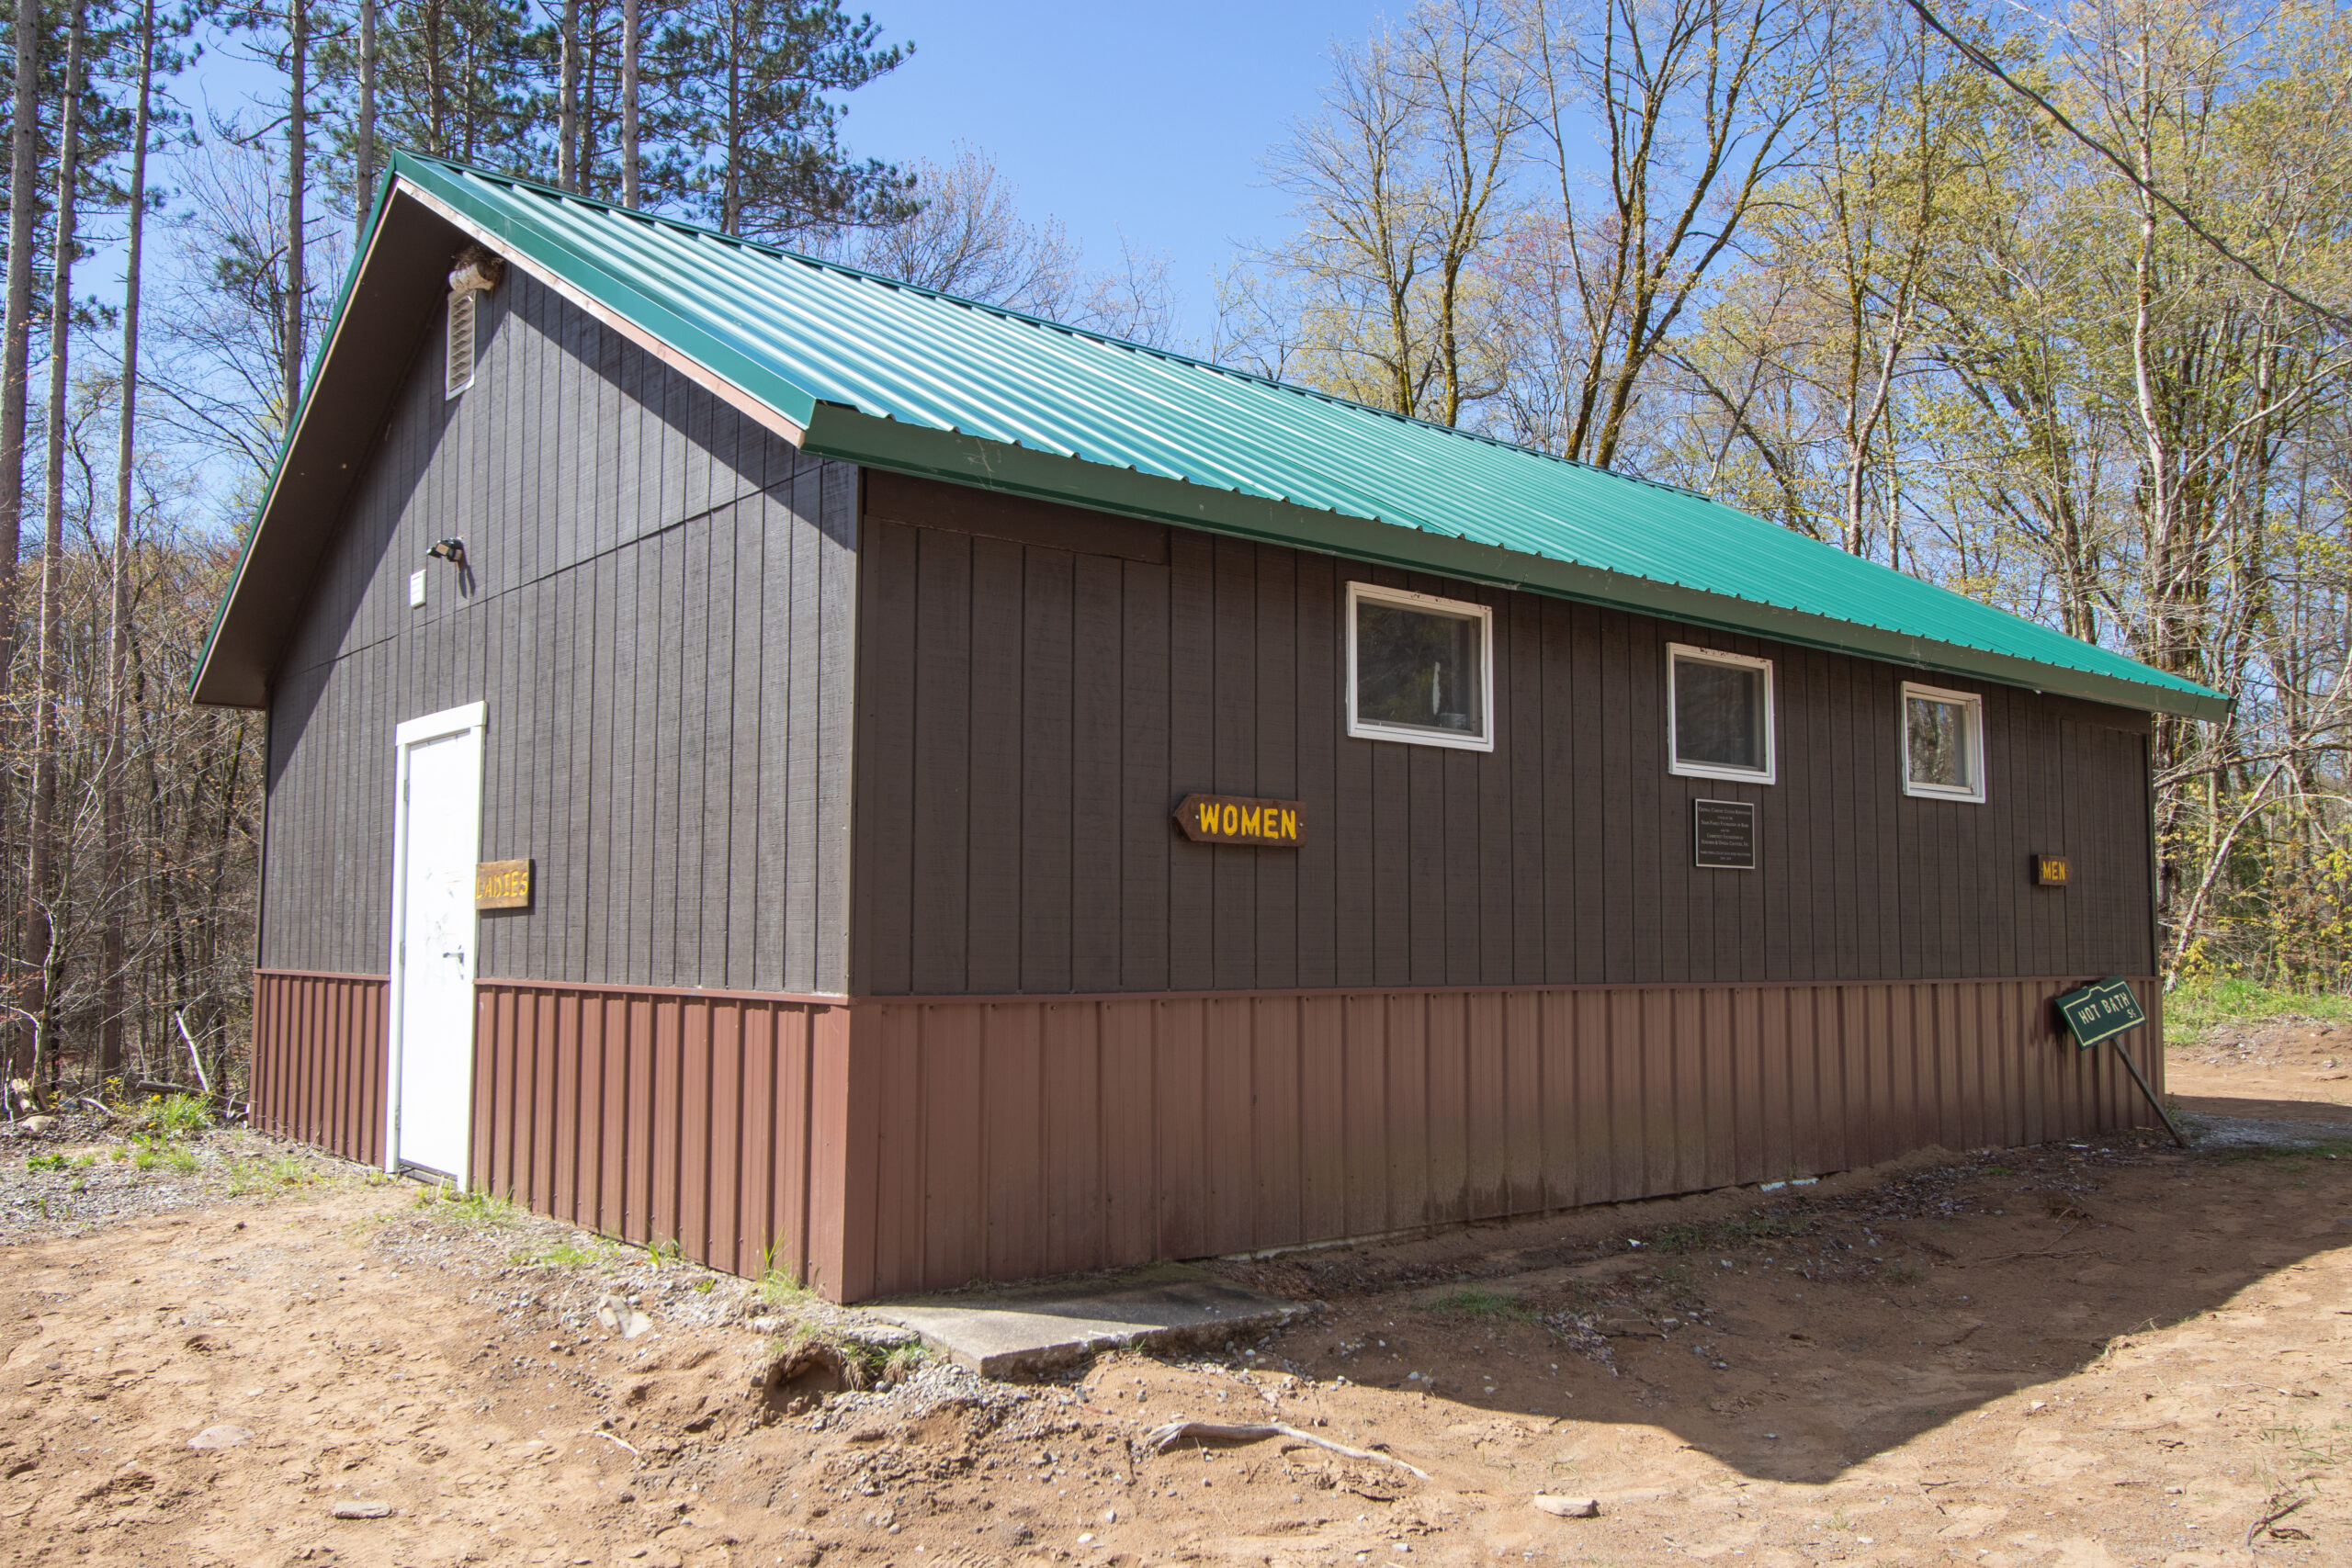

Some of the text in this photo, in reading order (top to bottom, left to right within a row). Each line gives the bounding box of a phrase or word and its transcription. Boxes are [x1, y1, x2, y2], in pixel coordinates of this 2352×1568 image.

[1200, 803, 1296, 840] WOMEN
[476, 870, 528, 898] LADIES
[2042, 860, 2065, 881] MEN
[2077, 991, 2131, 1025] HOT BATH
